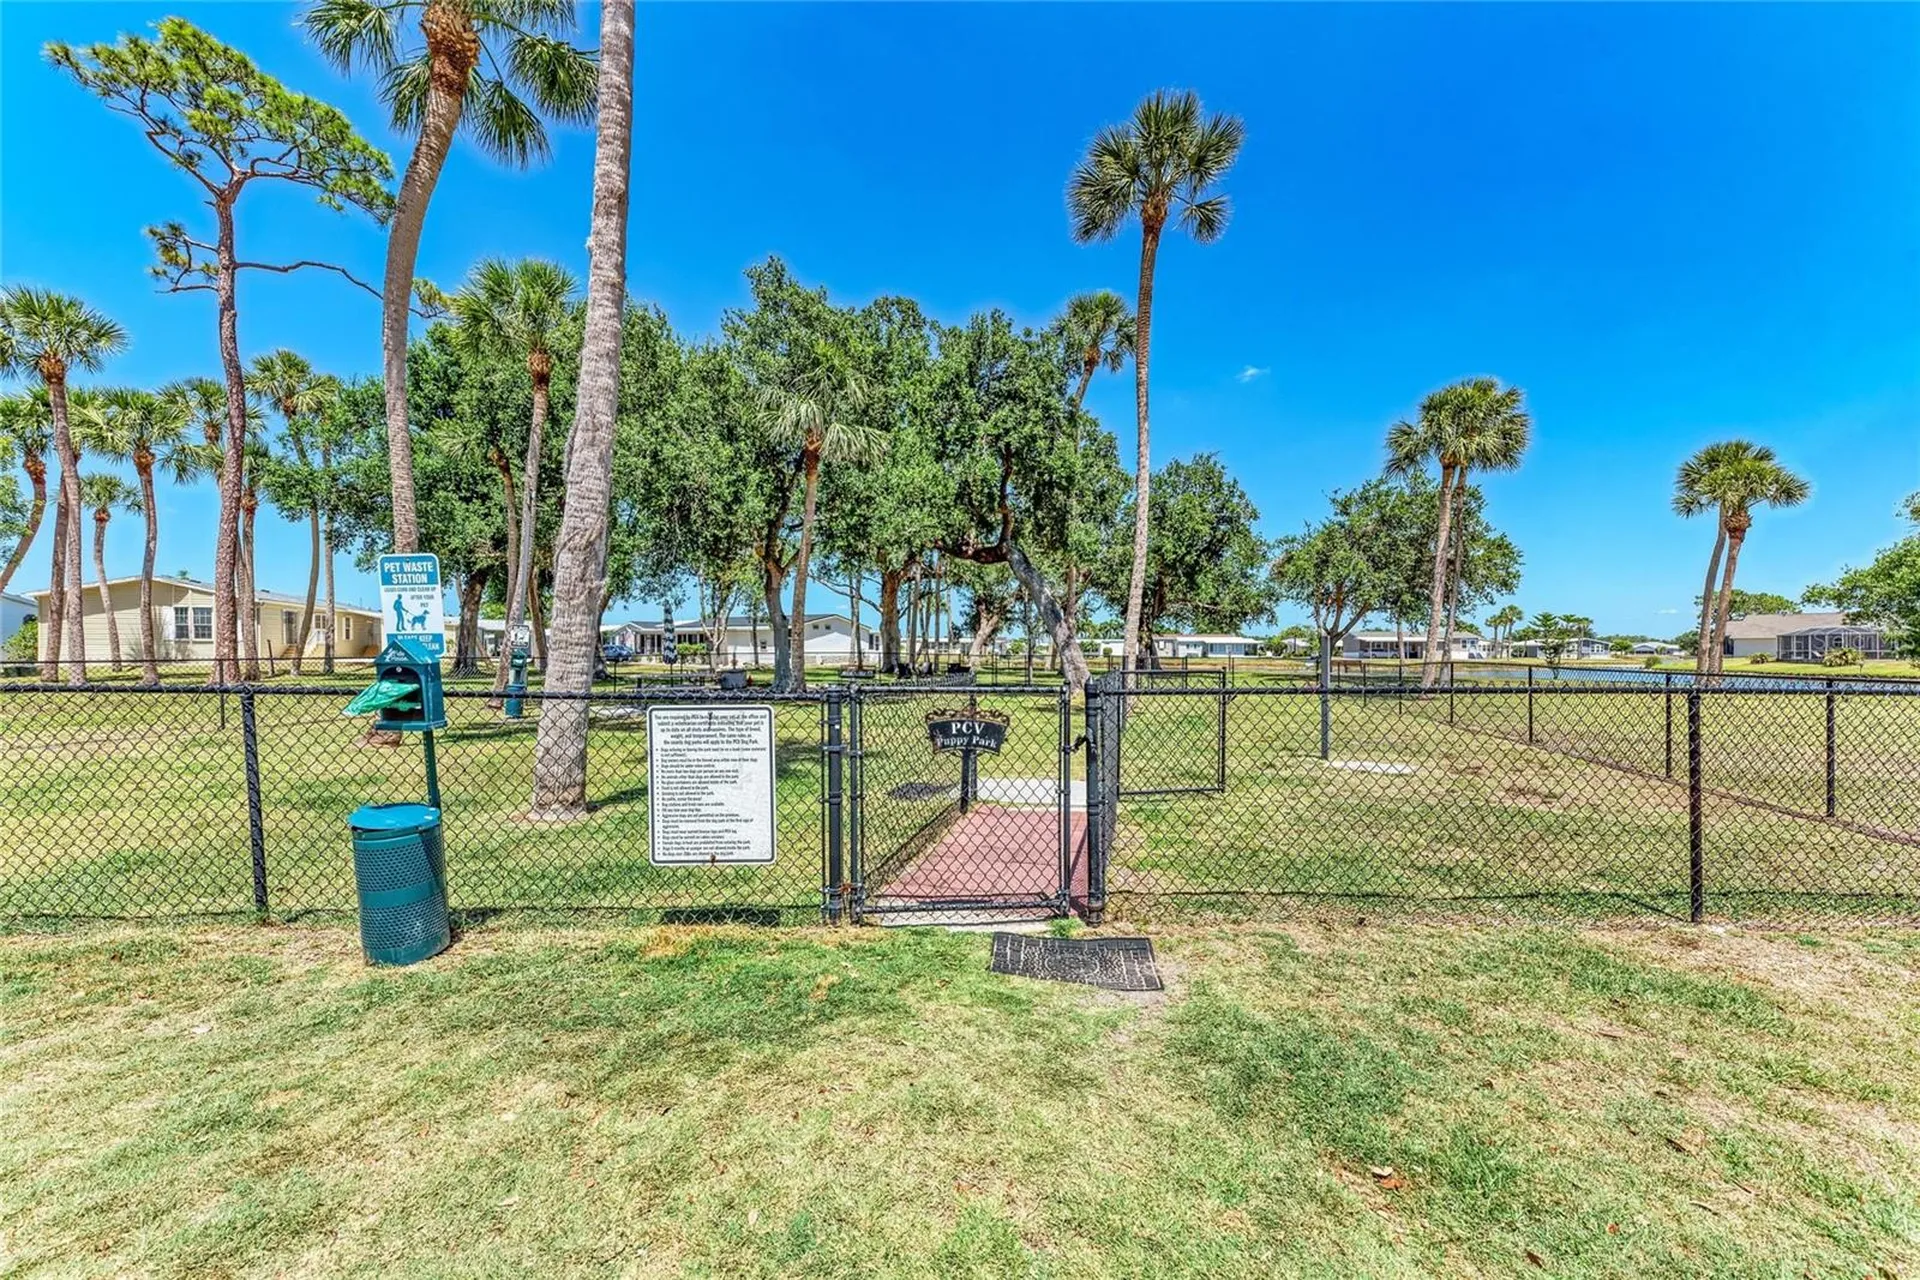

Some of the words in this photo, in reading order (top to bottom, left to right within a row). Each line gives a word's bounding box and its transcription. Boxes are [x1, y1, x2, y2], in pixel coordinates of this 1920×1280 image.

[384, 562, 400, 572] PET
[402, 562, 434, 572] WASTE
[392, 573, 428, 584] STATION
[951, 721, 986, 735] PCV
[937, 736, 969, 748] Puppy
[972, 735, 997, 748] Park
